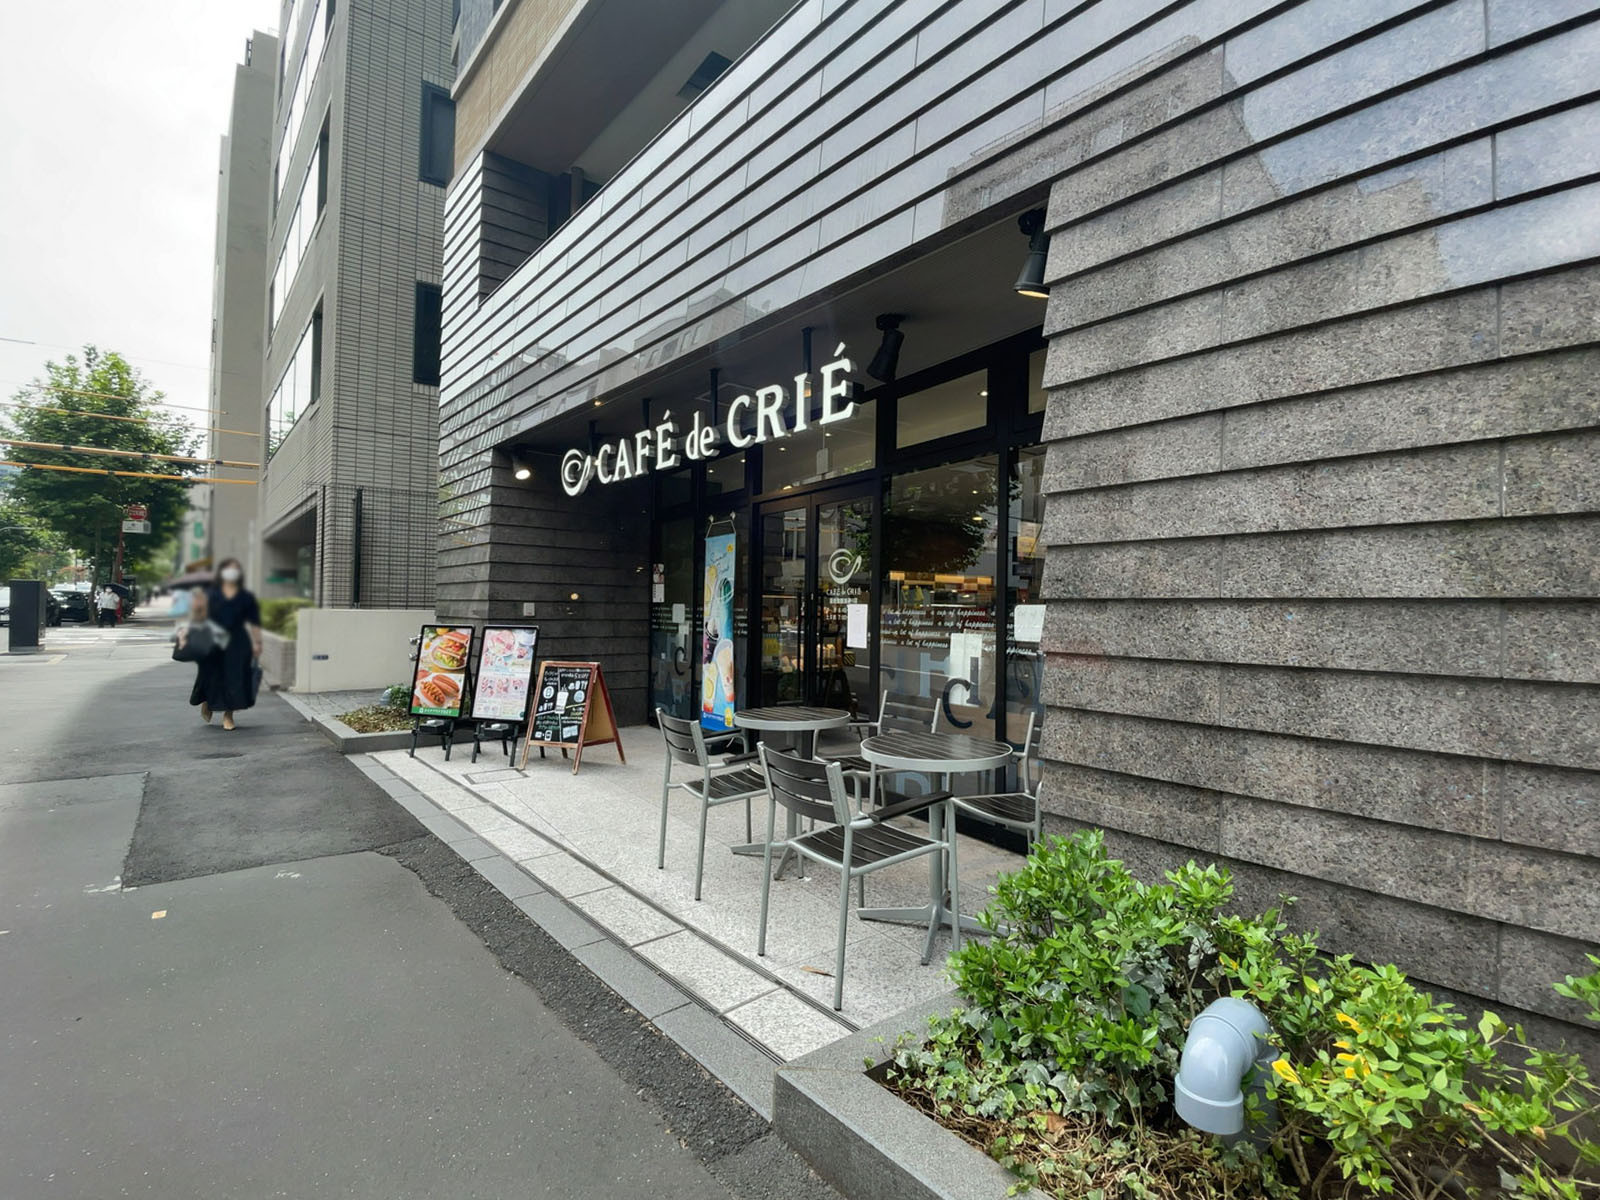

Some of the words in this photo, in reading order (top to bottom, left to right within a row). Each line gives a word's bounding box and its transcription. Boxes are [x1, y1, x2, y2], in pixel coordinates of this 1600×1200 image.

[597, 409, 680, 484] CAFÉ
[685, 410, 720, 460] de
[727, 342, 857, 448] CRIÉ
[957, 609, 986, 618] happiness
[909, 619, 934, 627] happiness
[964, 620, 995, 628] happiness
[921, 640, 949, 649] happiness
